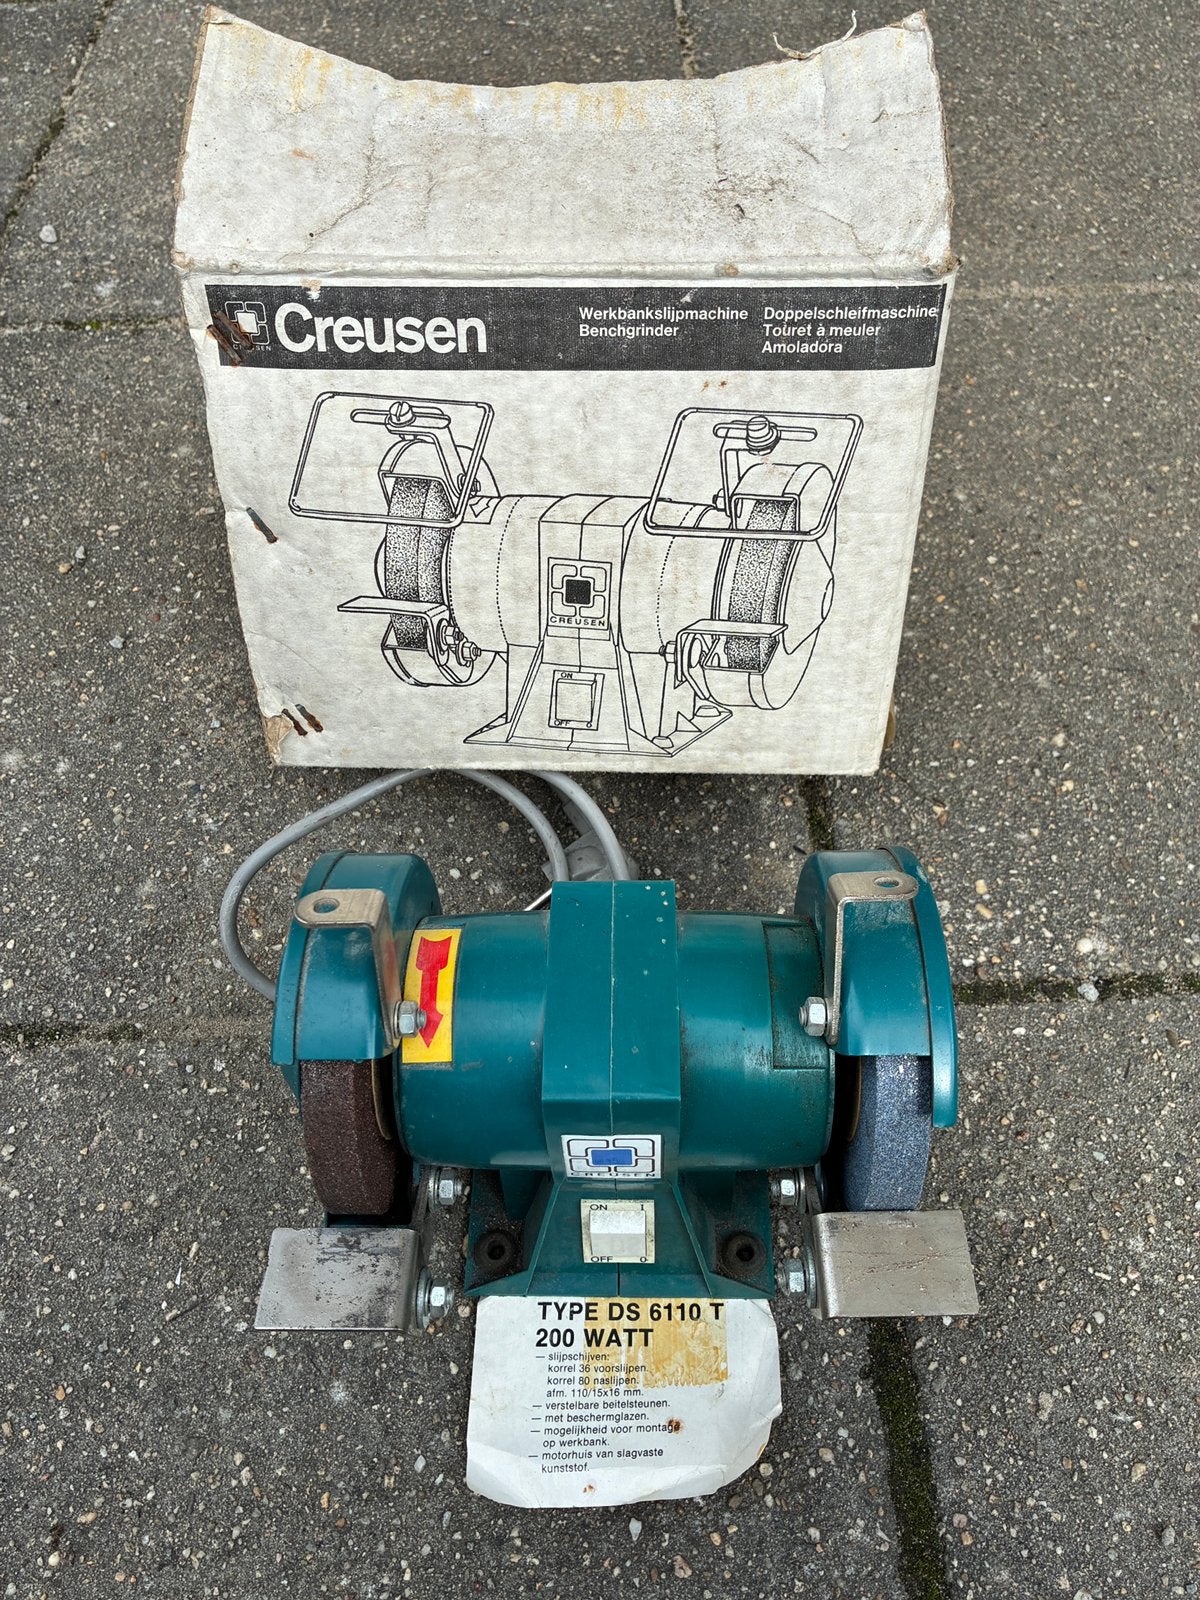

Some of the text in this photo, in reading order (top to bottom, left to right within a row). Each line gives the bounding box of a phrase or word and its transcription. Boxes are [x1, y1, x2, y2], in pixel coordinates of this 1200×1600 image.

[579, 307, 748, 322] Werkbankslijpmachine
[763, 305, 937, 322] Doppelschleifmaschine
[275, 302, 487, 354] Creusen
[579, 324, 679, 339] Benchgrinder
[763, 323, 881, 337] Touret à meuler
[762, 341, 843, 353] Amoladora
[550, 616, 606, 626] CREUSEN
[537, 1302, 724, 1321] TYPE DS 6110 T
[535, 1328, 654, 1347] 200 WATT
[548, 1352, 610, 1362] slijpschijven:
[548, 1364, 649, 1374] korrel 36 voorslijpen.
[547, 1376, 639, 1387] korrel 80 naslijpen.
[546, 1389, 643, 1398] afm. 110/15x16 mm.
[545, 1400, 670, 1410] verstelbare beitelsteunen.
[545, 1412, 649, 1424] met beschermglazen.
[544, 1425, 607, 1437] mogelijkheid
[610, 1425, 632, 1434] voor
[543, 1438, 610, 1449] op werkbank.
[542, 1448, 663, 1460] motorhuis van slagvaste
[541, 1463, 590, 1473] kunststof.
